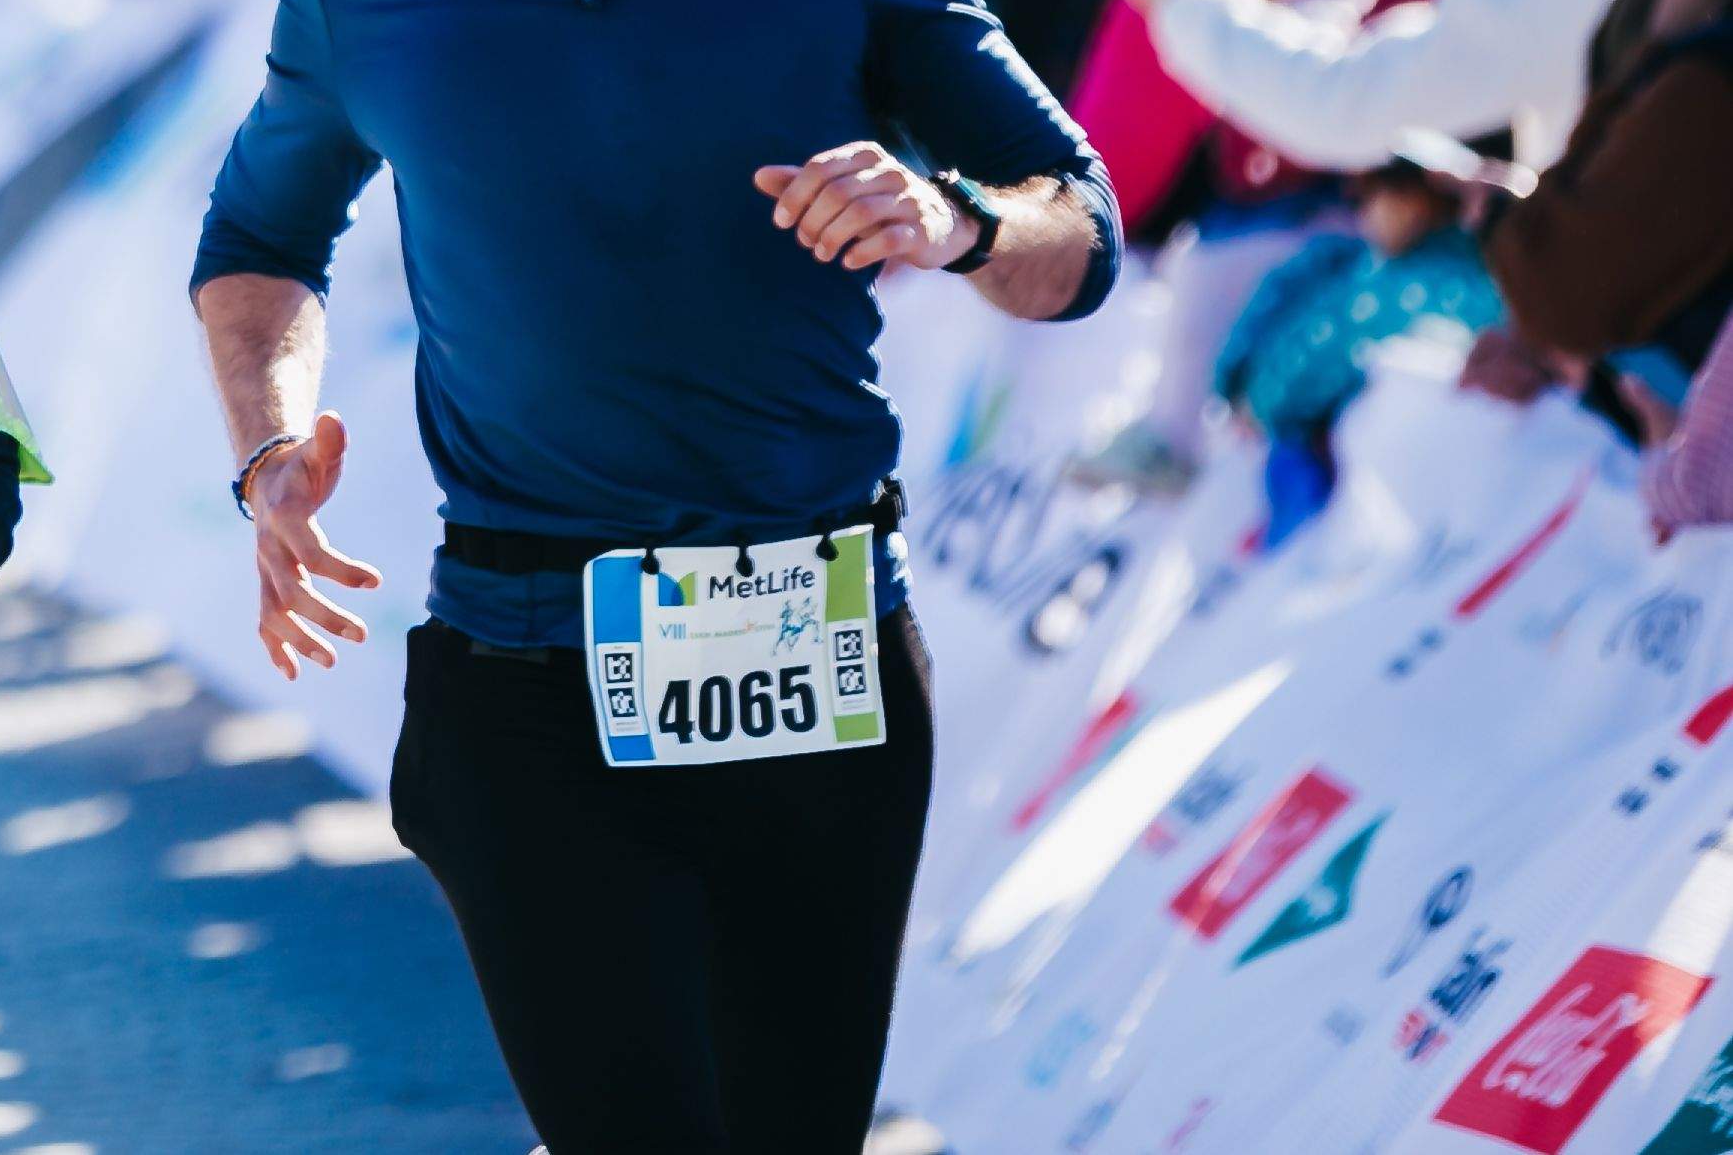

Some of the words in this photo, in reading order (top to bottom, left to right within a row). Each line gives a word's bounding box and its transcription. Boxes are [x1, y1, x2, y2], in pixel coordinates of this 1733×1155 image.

[708, 564, 817, 600] MetLife
[658, 622, 687, 641] VIII
[657, 663, 820, 745] 4065
